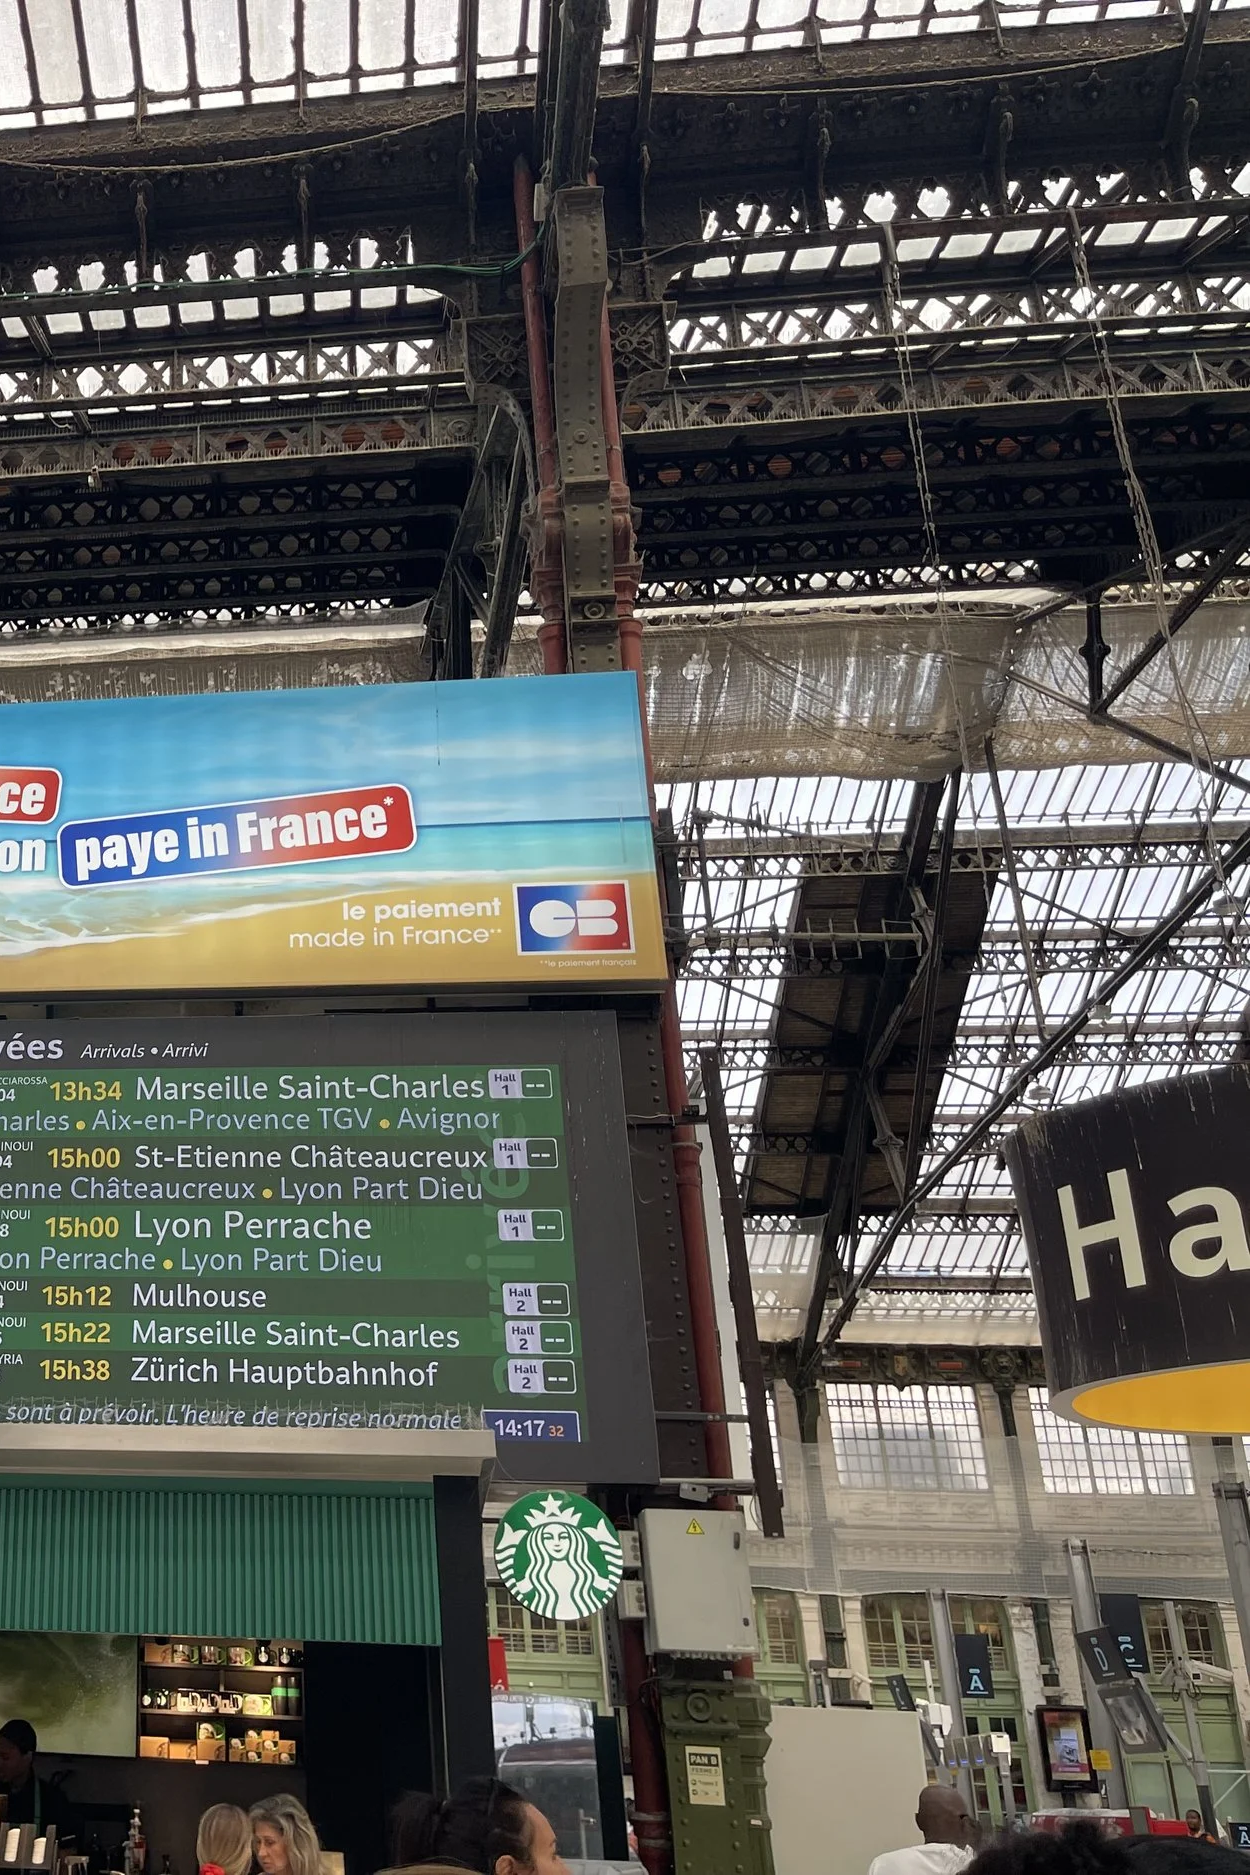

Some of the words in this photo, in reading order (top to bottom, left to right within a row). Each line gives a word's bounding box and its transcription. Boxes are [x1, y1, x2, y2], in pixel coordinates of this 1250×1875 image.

[75, 825, 179, 880] paye
[187, 816, 228, 858] in
[342, 901, 366, 920] le
[375, 897, 502, 923] paiement
[290, 929, 364, 947] made
[373, 927, 395, 946] in
[557, 959, 599, 968] paiement
[602, 958, 636, 967] français
[81, 1044, 144, 1059] Arrivals
[162, 1043, 209, 1058] Arrivi
[50, 1081, 122, 1100] 13h34
[136, 1076, 268, 1100] Marseille
[278, 1074, 484, 1099] Saint-Charles
[494, 1073, 516, 1083] Hall
[502, 1085, 509, 1095] 1
[92, 1107, 310, 1131] Aix-en-Provence
[317, 1107, 372, 1129] TGV
[47, 1148, 120, 1168] 15h00
[135, 1145, 282, 1168] St-Etienne
[290, 1145, 488, 1168] Châteaucreux
[71, 1175, 255, 1199] Châteaucreux
[280, 1177, 342, 1205] Lyon
[352, 1177, 409, 1200] Part
[419, 1177, 483, 1200] Dieu
[45, 1217, 119, 1238] 15h00
[135, 1210, 210, 1245] Lyon
[224, 1211, 372, 1239] Perrache
[40, 1247, 155, 1270] Perrache
[181, 1248, 242, 1276] Lyon
[253, 1249, 309, 1271] Part
[319, 1248, 382, 1272] Dieu
[42, 1286, 111, 1306] 15h12
[133, 1283, 267, 1308] Mulhouse
[41, 1322, 111, 1343] 15h22
[132, 1320, 256, 1345] Marseille
[266, 1321, 460, 1348] Saint-Charles
[39, 1360, 110, 1381] 15h38
[131, 1357, 217, 1382] Zürich
[229, 1359, 439, 1390] Hauptbahnhof
[494, 1419, 545, 1437] 14:17
[549, 1425, 564, 1437] 32
[970, 1675, 984, 1690] A
